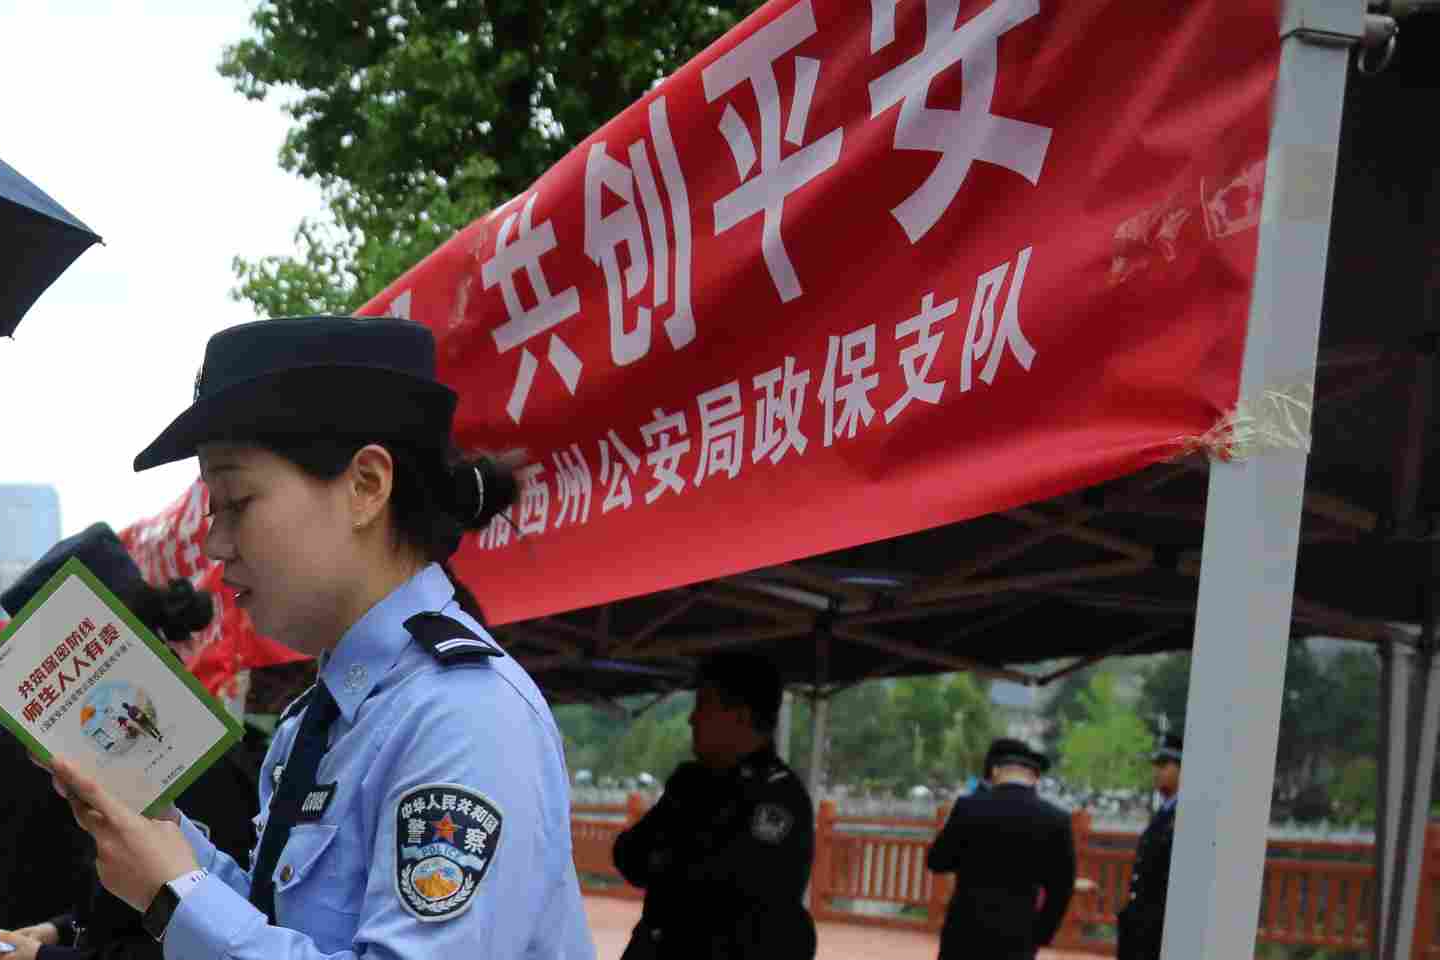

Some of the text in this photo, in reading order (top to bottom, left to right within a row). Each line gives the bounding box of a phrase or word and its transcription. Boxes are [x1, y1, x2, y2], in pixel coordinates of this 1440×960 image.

[479, 0, 1054, 425] 共创平安
[401, 794, 499, 834] 中华人民共和国
[407, 818, 488, 854] 警 察
